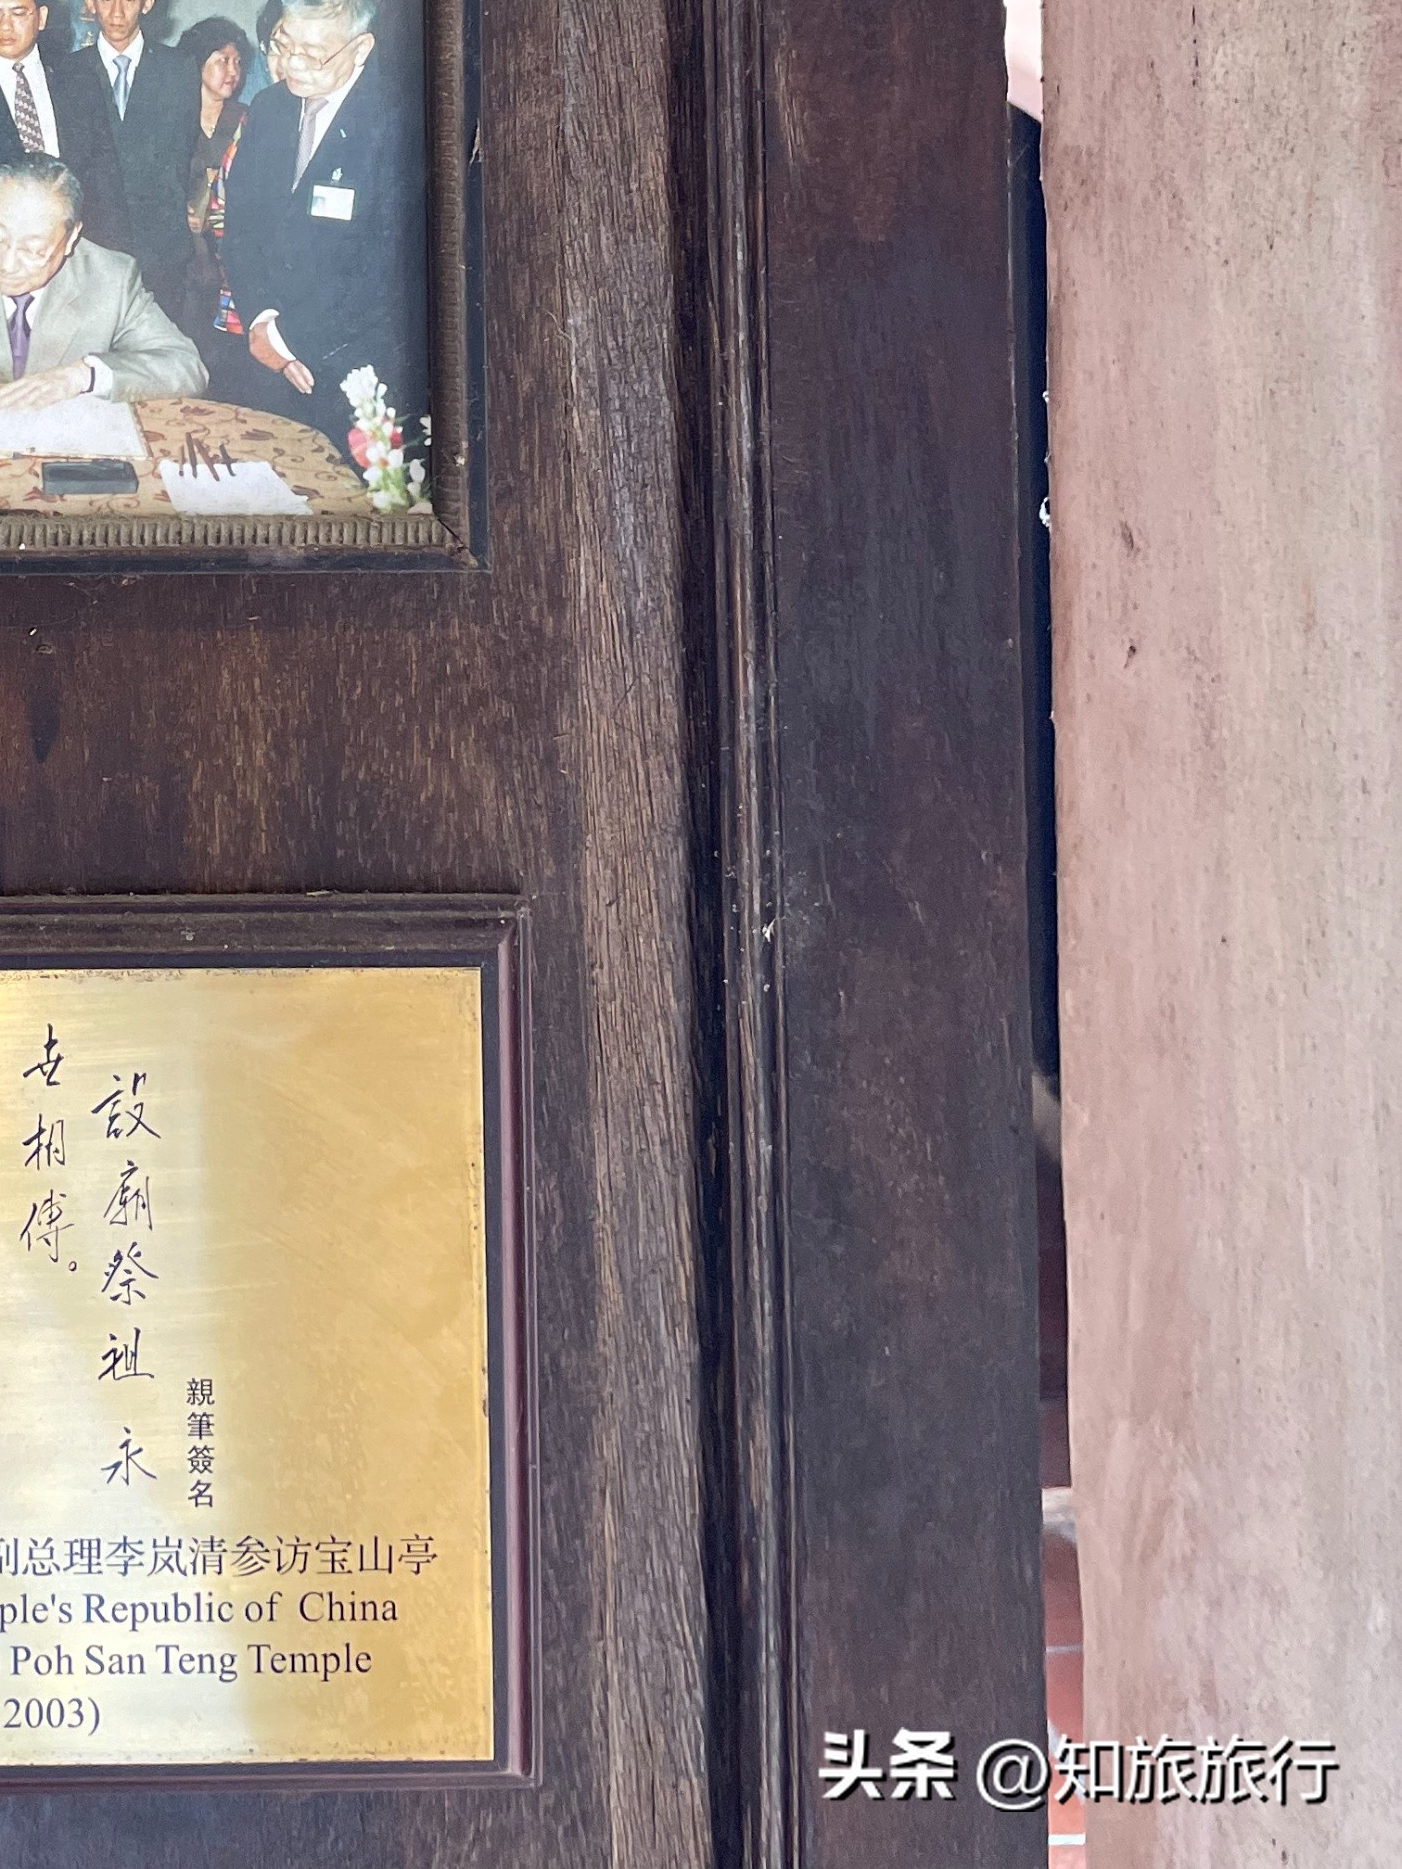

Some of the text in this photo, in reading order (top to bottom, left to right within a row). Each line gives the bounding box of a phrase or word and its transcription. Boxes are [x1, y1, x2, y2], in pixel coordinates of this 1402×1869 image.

[185, 1377, 215, 1508] 親筆簽名
[82, 1591, 233, 1632] Republic
[244, 1590, 282, 1622] of
[299, 1590, 398, 1622] China
[10, 1644, 74, 1676] Poh
[85, 1644, 146, 1675] San
[155, 1644, 238, 1683] Teng
[246, 1642, 372, 1682] Temple
